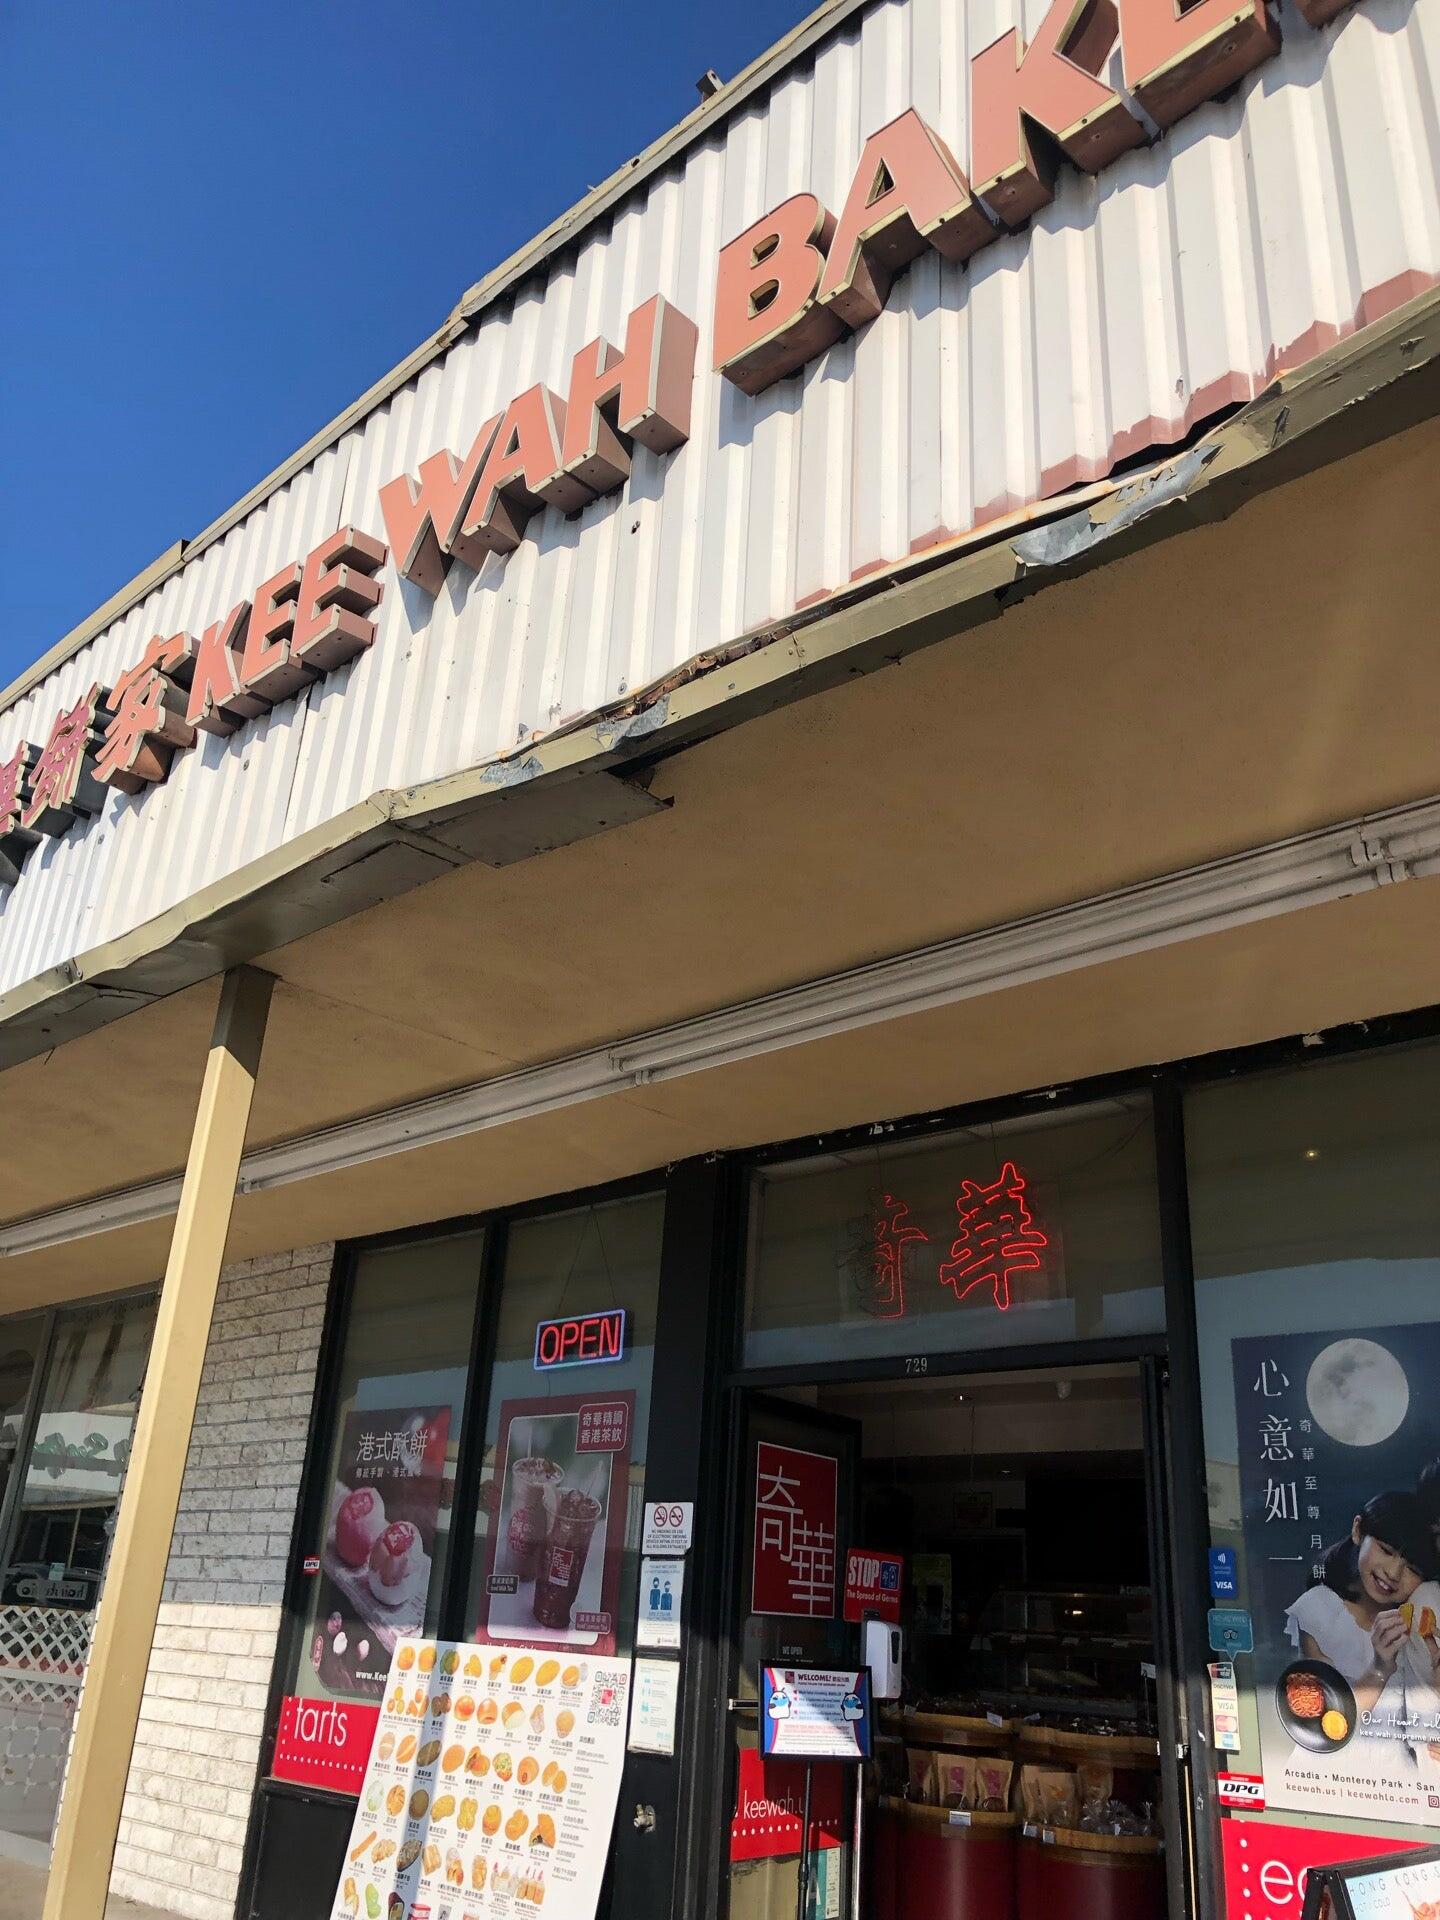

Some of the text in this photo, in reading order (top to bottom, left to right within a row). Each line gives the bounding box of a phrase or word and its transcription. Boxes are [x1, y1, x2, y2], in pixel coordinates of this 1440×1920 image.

[186, 524, 370, 728] KEE
[378, 293, 672, 580] WAH
[540, 1316, 620, 1364] OPEN
[905, 1357, 928, 1374] 729
[1253, 1359, 1303, 1561] 心意如一
[1299, 1419, 1327, 1579] 奇華至尊月餅
[848, 1556, 880, 1588] STOP
[1215, 1581, 1233, 1590] VISA
[847, 1589, 855, 1599] The
[875, 1592, 881, 1602] of
[882, 1592, 898, 1603] Germs
[798, 1673, 832, 1682] WELCOME!
[1217, 1701, 1234, 1710] VISA
[294, 1698, 348, 1747] tarts
[1361, 1710, 1382, 1726] Our
[1387, 1712, 1420, 1728] Heart
[1359, 1729, 1373, 1738] kee
[1376, 1730, 1391, 1739] wah
[1393, 1731, 1427, 1742] supreme
[1223, 1783, 1260, 1796] DPG
[1284, 1769, 1435, 1792] Arcadia Monterey Park San
[1286, 1783, 1337, 1796] keewah.us
[1349, 1878, 1386, 1897] HONG
[1395, 1869, 1428, 1888] KONG
